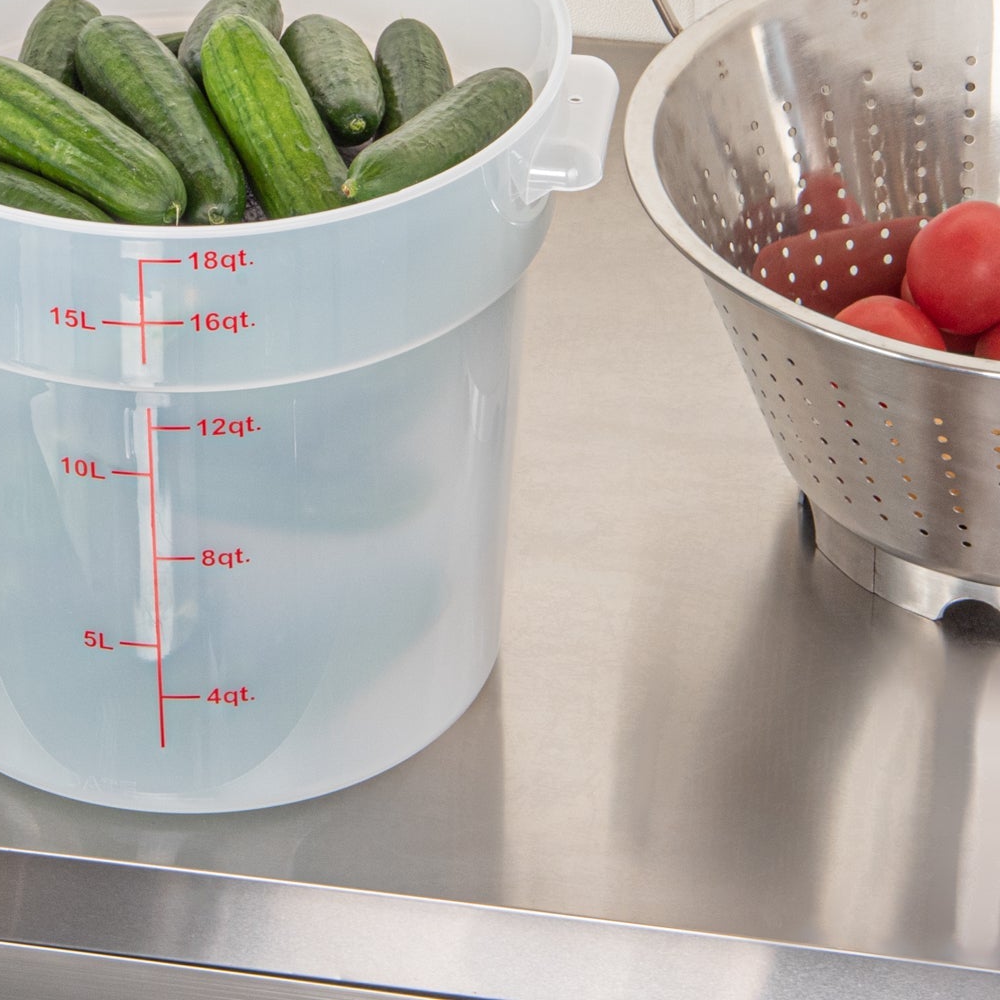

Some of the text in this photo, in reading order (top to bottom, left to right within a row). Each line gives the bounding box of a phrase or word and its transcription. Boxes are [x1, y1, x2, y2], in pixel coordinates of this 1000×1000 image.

[188, 249, 253, 272] 18qt.
[50, 307, 96, 331] 15L
[191, 311, 255, 334] 16qt.
[197, 416, 261, 437] 12qt.
[61, 457, 106, 480] 10L
[201, 548, 250, 568] 8qt.
[84, 630, 113, 650] 5L
[207, 686, 254, 707] 4qt.
